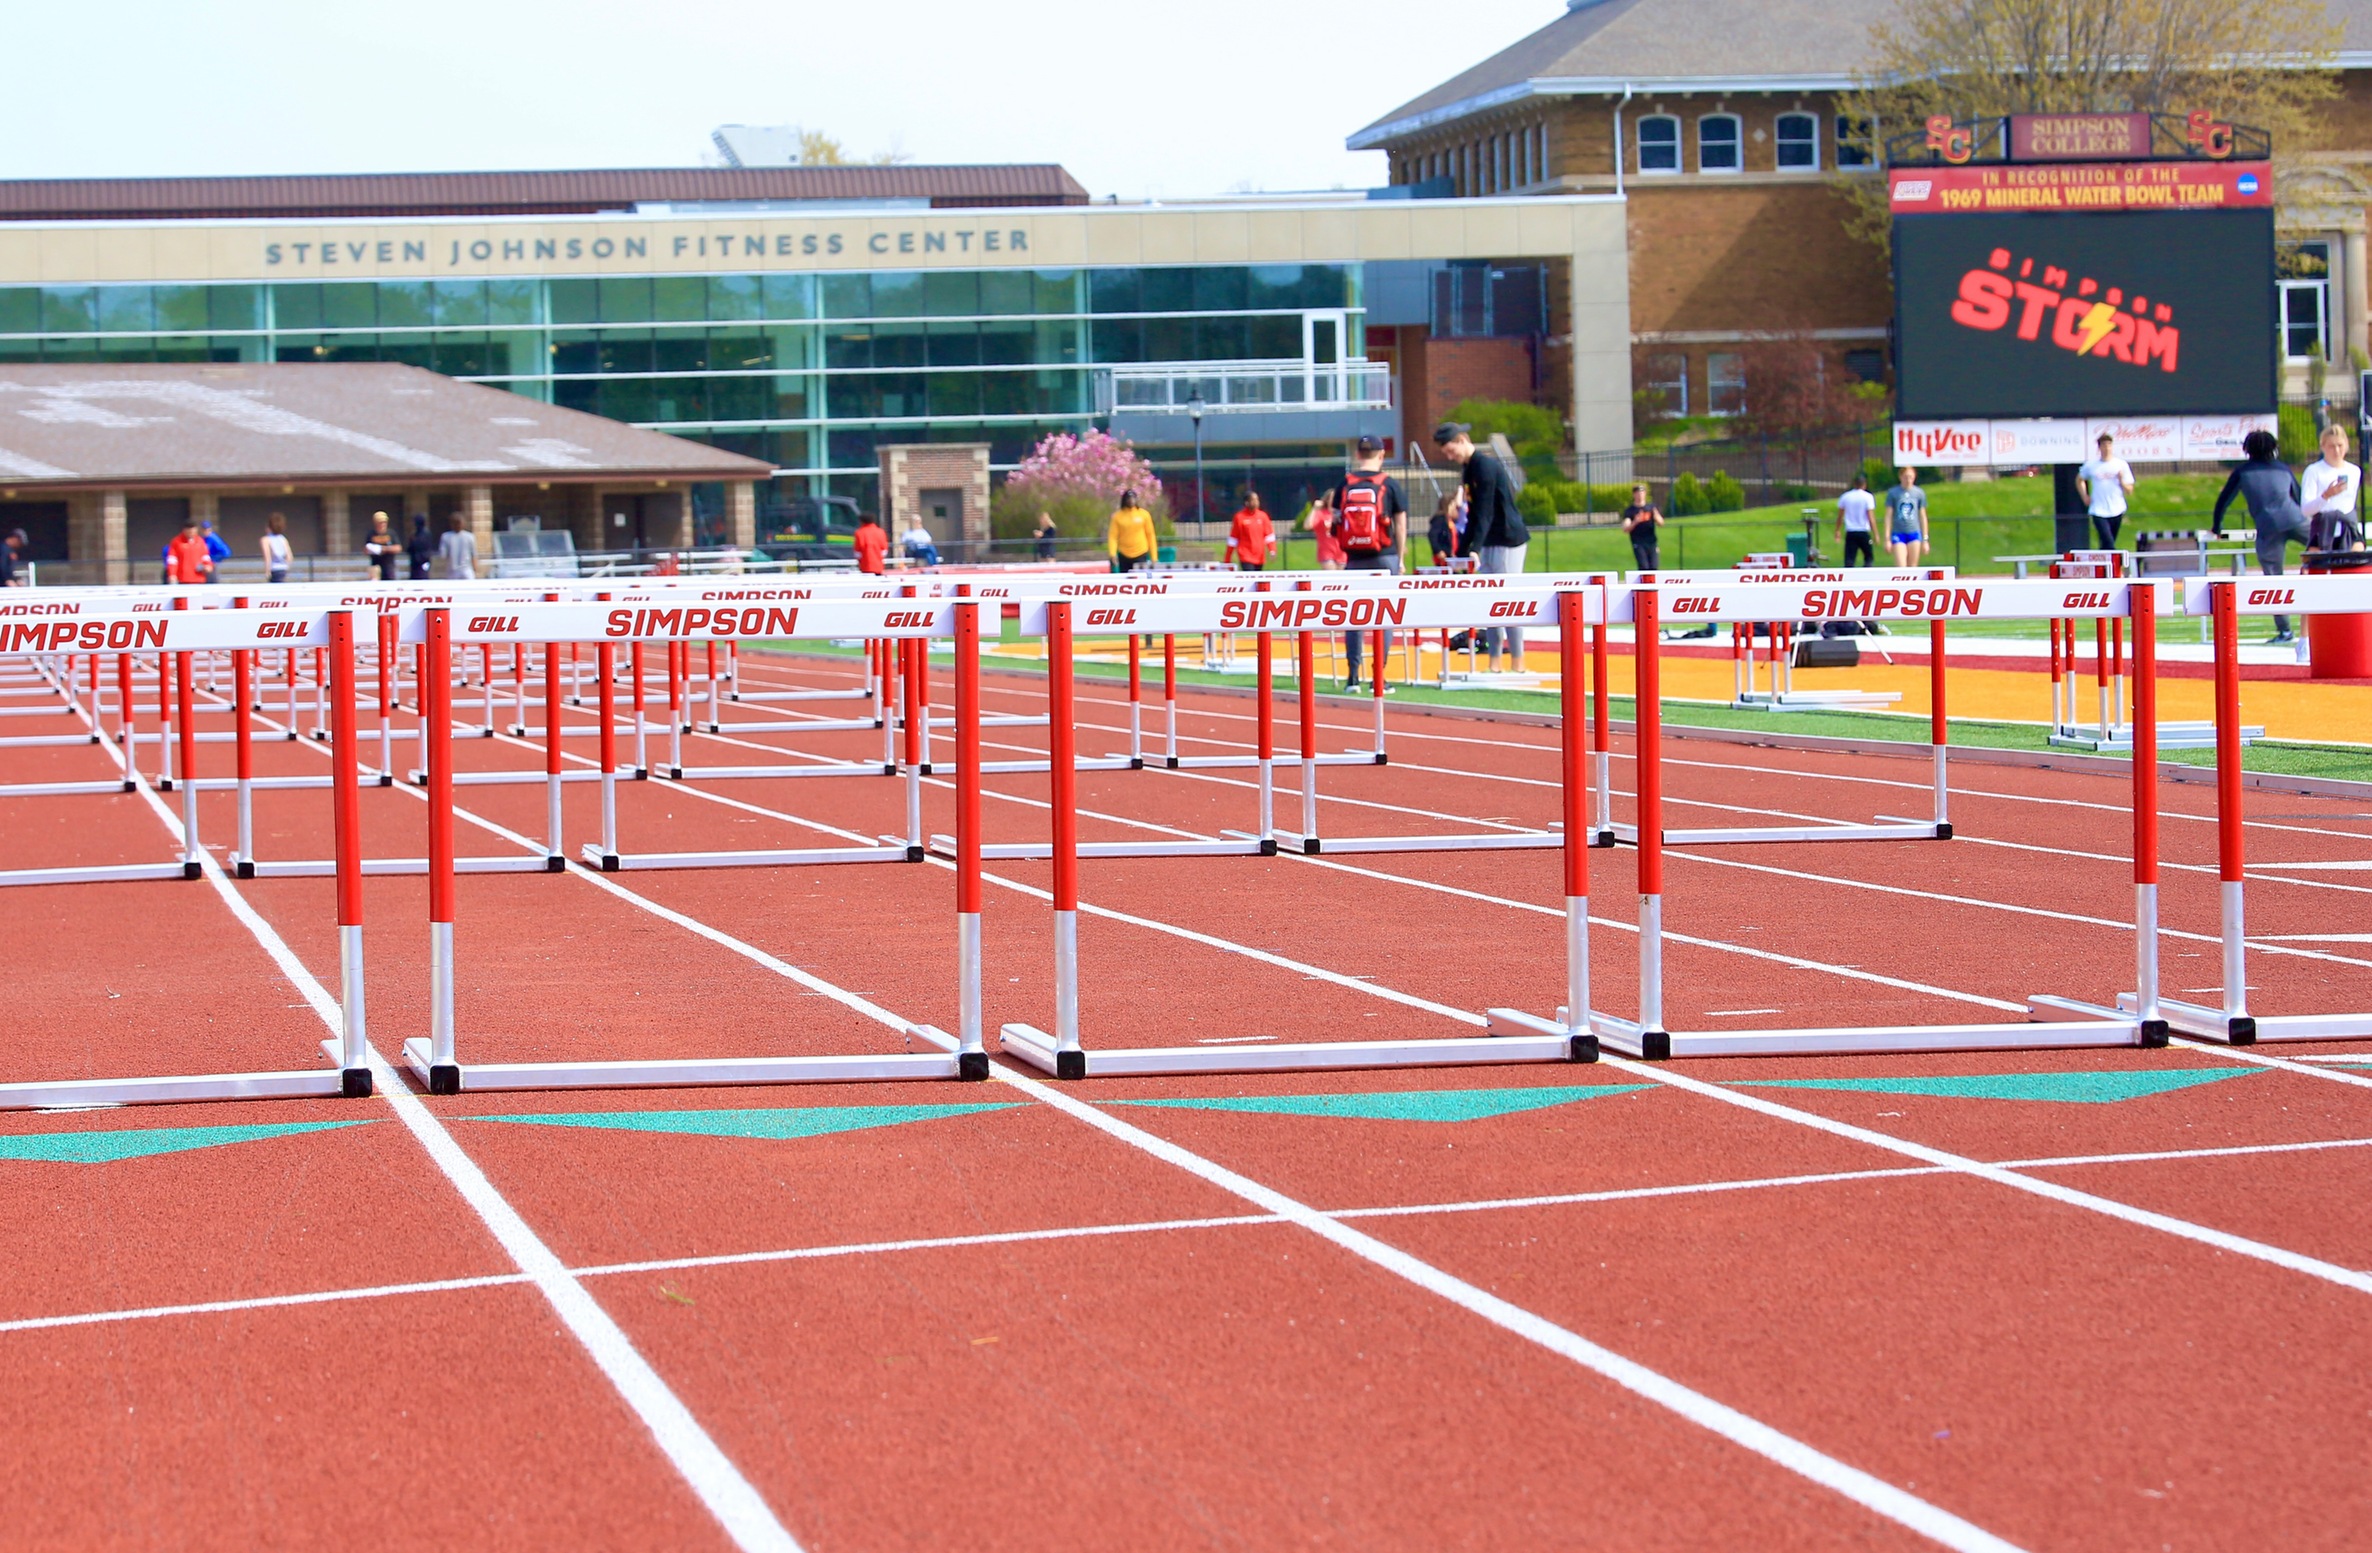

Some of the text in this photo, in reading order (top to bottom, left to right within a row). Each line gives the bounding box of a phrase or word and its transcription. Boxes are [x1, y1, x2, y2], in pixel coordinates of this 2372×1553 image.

[2032, 118, 2129, 135] SIMPSON
[2031, 135, 2131, 153] COLLEGE
[1982, 167, 2180, 186] IN RECOGNITION OF THE
[1940, 188, 1982, 208] 1969
[1985, 186, 2062, 207] MINERAL
[2063, 185, 2122, 206] WATER
[2124, 184, 2176, 205] BOWL
[2177, 183, 2224, 203] TEAM
[266, 229, 1029, 266] STEVEN JOHNSON FITNESS CENTER
[1951, 269, 2179, 372] STORM
[2020, 434, 2081, 447] DOWNING
[980, 588, 1009, 598] GILL
[1672, 588, 2110, 617] GILL SIMPSON GILL
[2247, 589, 2295, 605] GILL
[132, 603, 161, 612] GILL
[1086, 598, 1538, 628] GILL SIMPSON GILL
[468, 607, 934, 636] GILL SIMPSON GILL
[0, 620, 309, 651] IMPSON GILL
